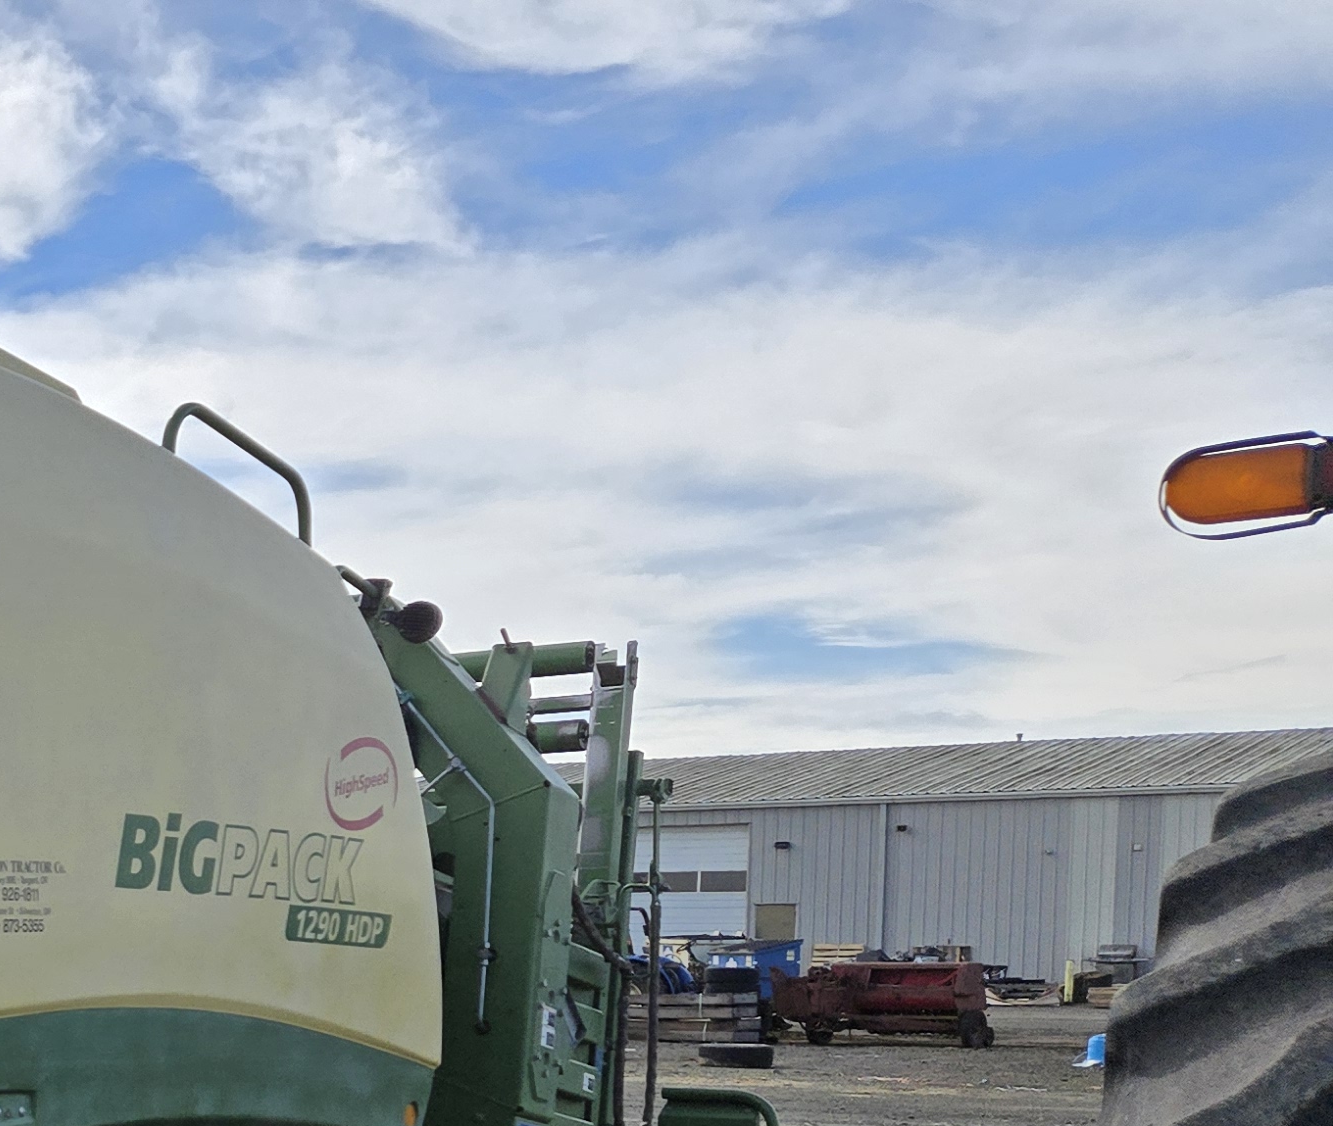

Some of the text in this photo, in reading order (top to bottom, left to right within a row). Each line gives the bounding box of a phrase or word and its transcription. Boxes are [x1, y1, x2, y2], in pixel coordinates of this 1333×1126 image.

[334, 767, 389, 798] HighSpeed
[10, 860, 52, 873] TRACTOR
[1, 887, 39, 901] 926-1811
[296, 909, 383, 944] 1290 HDP
